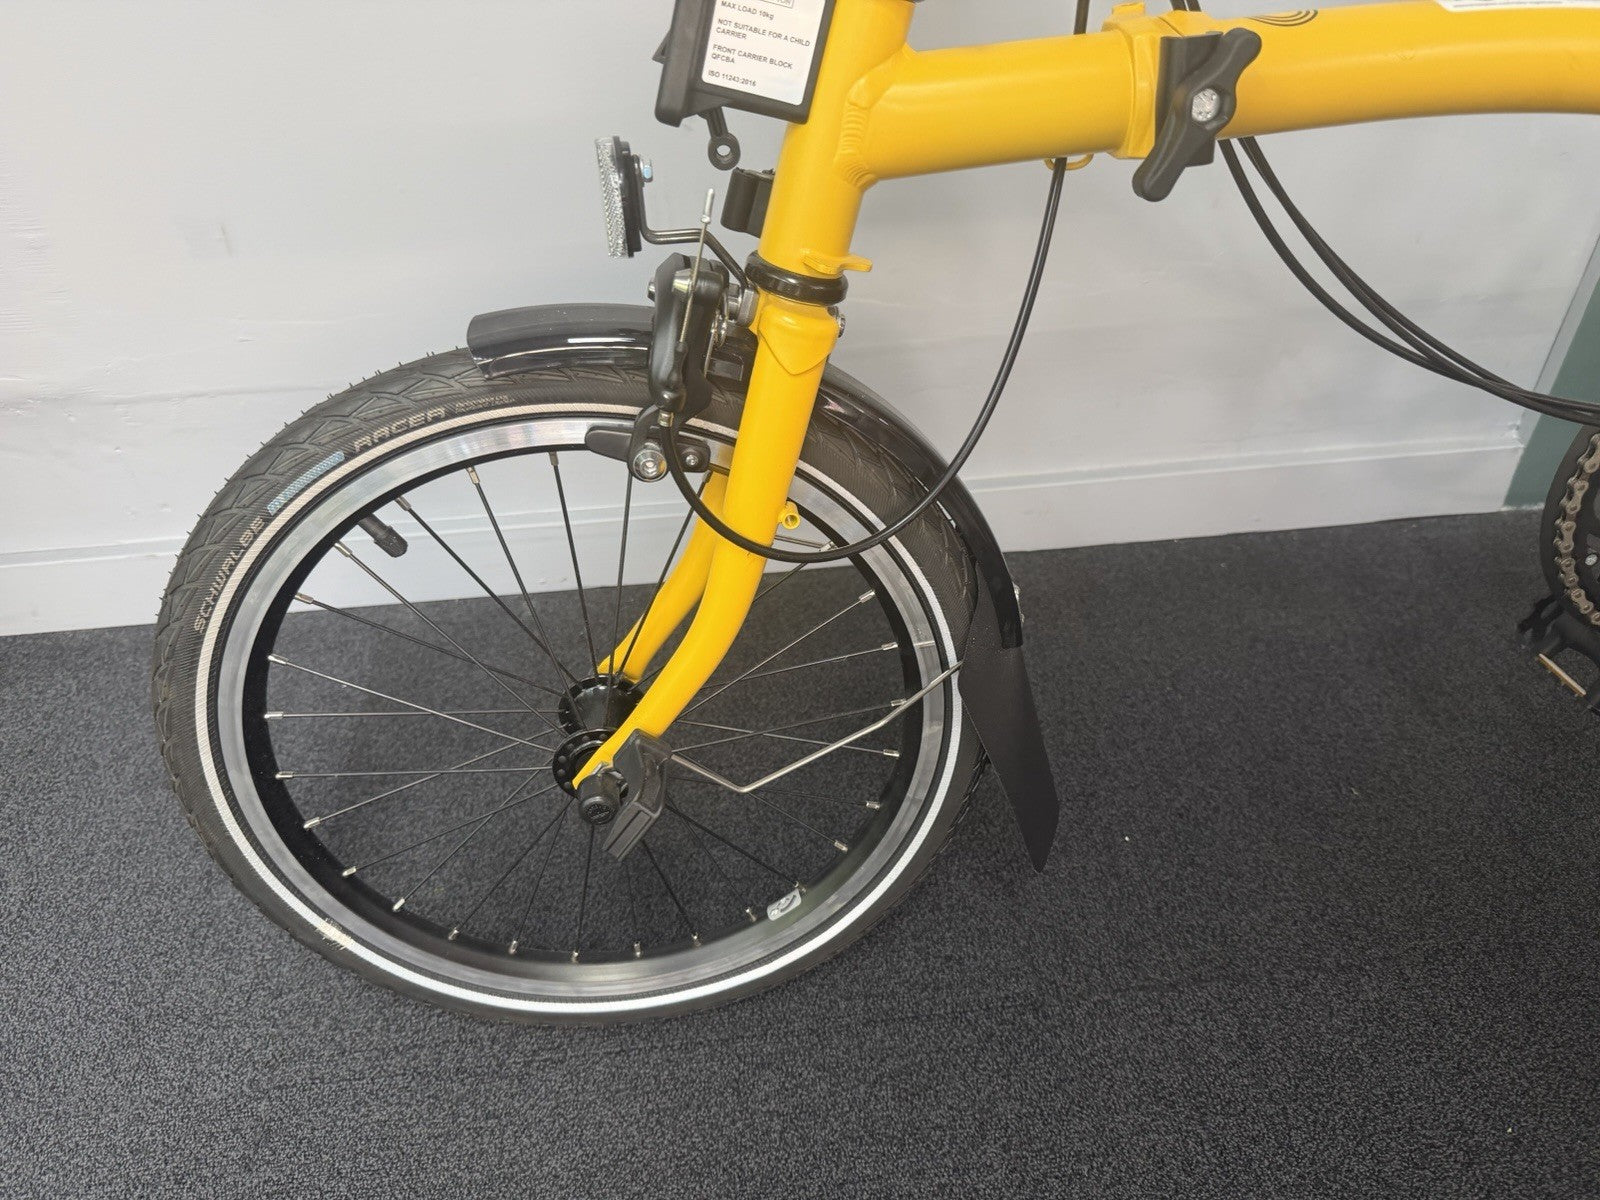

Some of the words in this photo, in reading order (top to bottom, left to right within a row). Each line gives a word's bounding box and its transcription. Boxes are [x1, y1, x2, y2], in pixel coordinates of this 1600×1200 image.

[721, 1, 736, 9] MAX
[738, 6, 757, 15] LOAD
[759, 10, 774, 20] 10kg
[716, 27, 747, 40] CARRIER
[718, 18, 732, 27] NOT
[734, 22, 767, 36] SUITABLE
[768, 31, 782, 40] FOR
[790, 36, 810, 47] CHILD
[711, 53, 735, 63] QFCBA
[713, 44, 736, 55] FRONT
[737, 50, 767, 63] CARRIER
[769, 58, 793, 69] BLOCK
[708, 70, 720, 78] ISO
[354, 407, 446, 453] RACER
[193, 515, 265, 633] SCHWALBE
